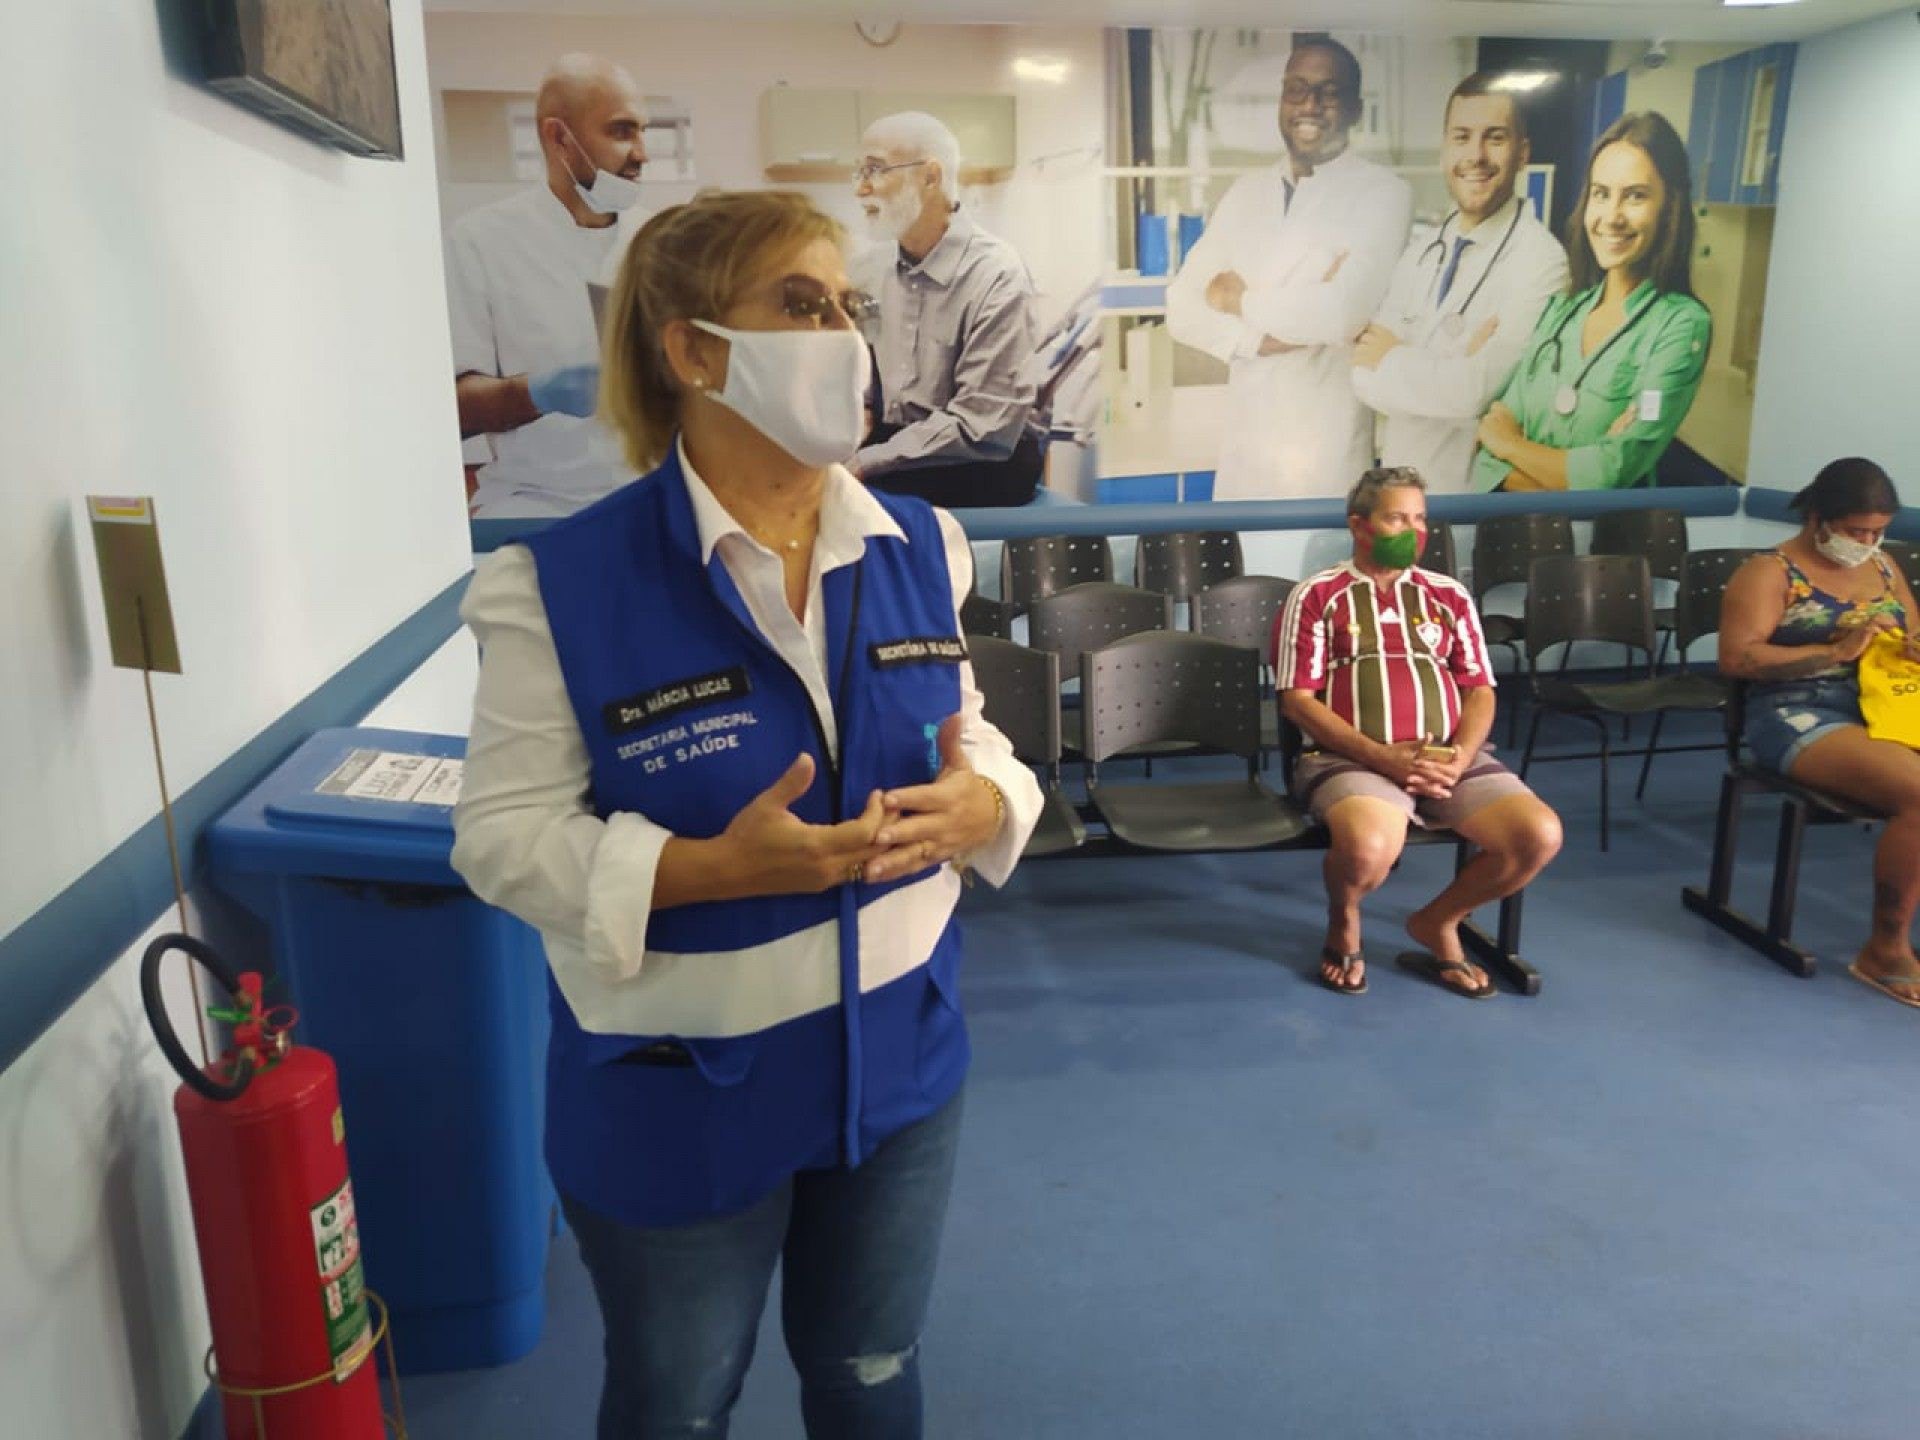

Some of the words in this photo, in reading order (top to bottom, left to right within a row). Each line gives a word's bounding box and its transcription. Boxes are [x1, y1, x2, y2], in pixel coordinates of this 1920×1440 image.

[646, 686, 691, 712] MÁRCIA
[693, 677, 732, 698] LUCAS
[691, 711, 759, 735] MUNICIPAL
[643, 755, 668, 774] DE
[675, 734, 740, 763] SAÚDE
